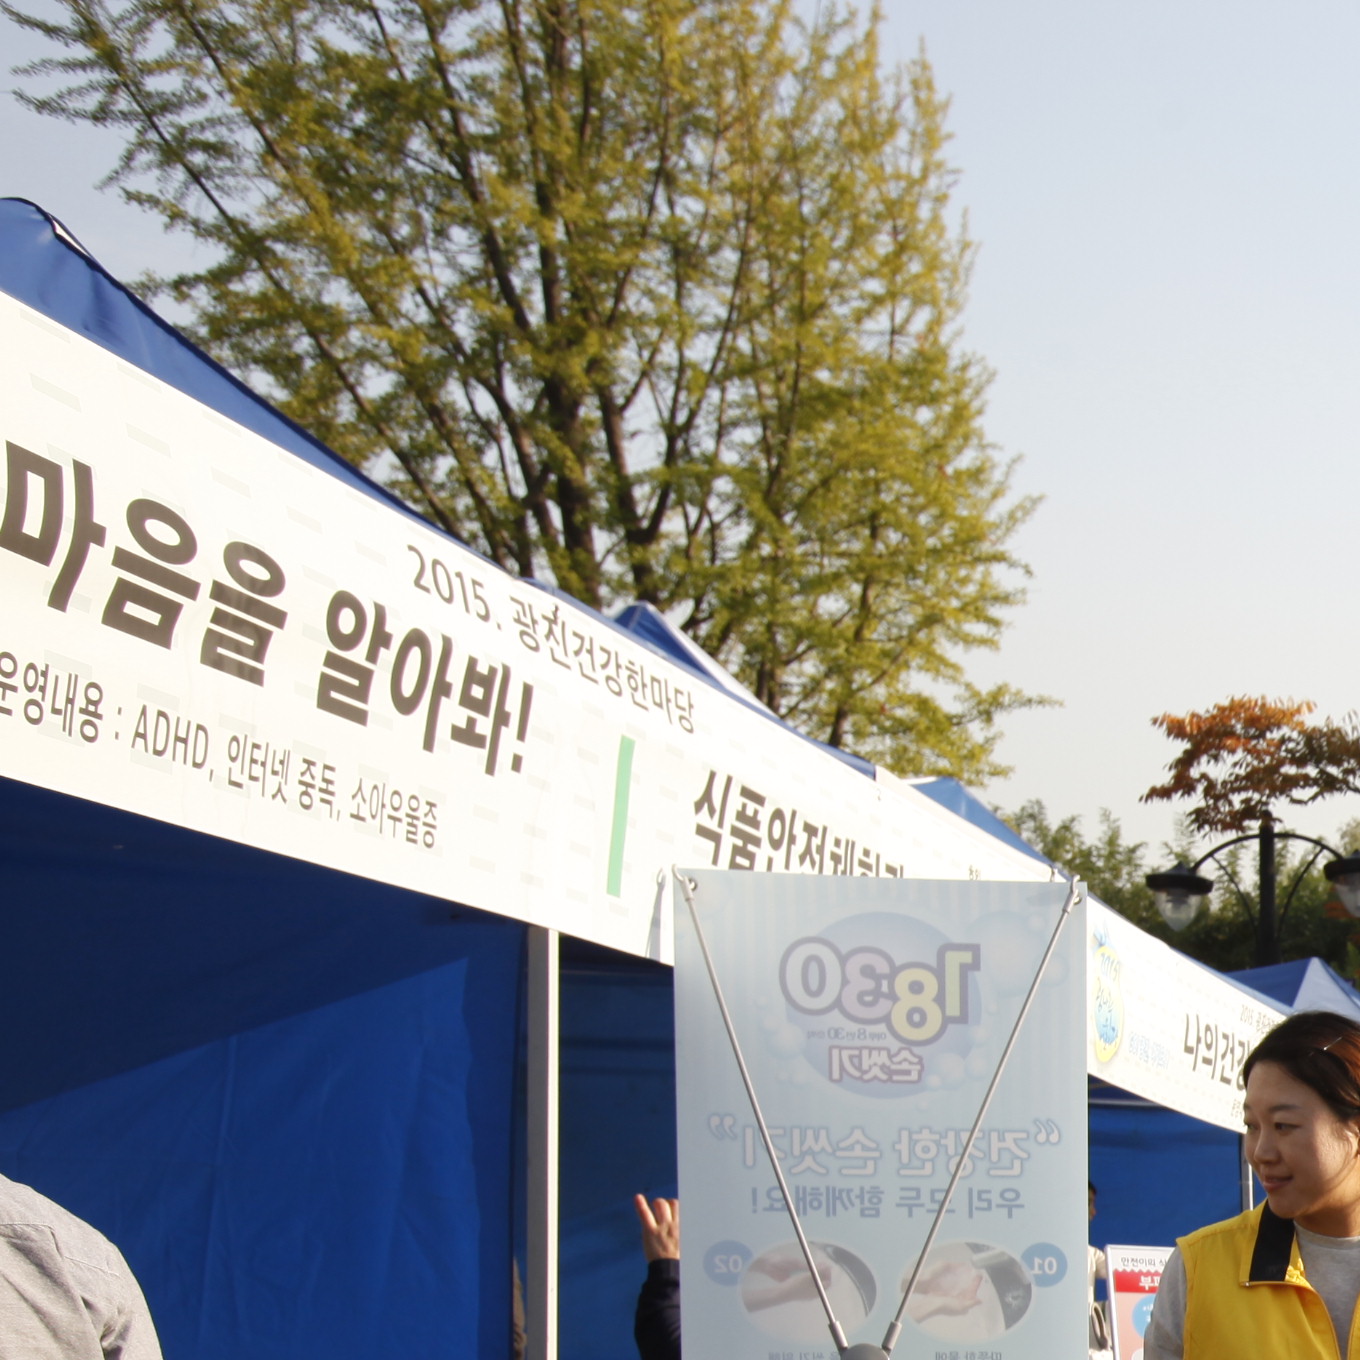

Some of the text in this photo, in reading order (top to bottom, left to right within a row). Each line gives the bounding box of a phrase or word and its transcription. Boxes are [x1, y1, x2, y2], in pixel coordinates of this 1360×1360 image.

[0, 440, 534, 777] 마음을 알아봐!
[406, 544, 694, 734] 2015. 광진건강한마당
[0, 651, 104, 743] 운영내용
[131, 704, 214, 782] ADHD,
[227, 733, 290, 805] 인터넷
[298, 756, 341, 822] 중독,
[350, 776, 438, 849] 소아우울증
